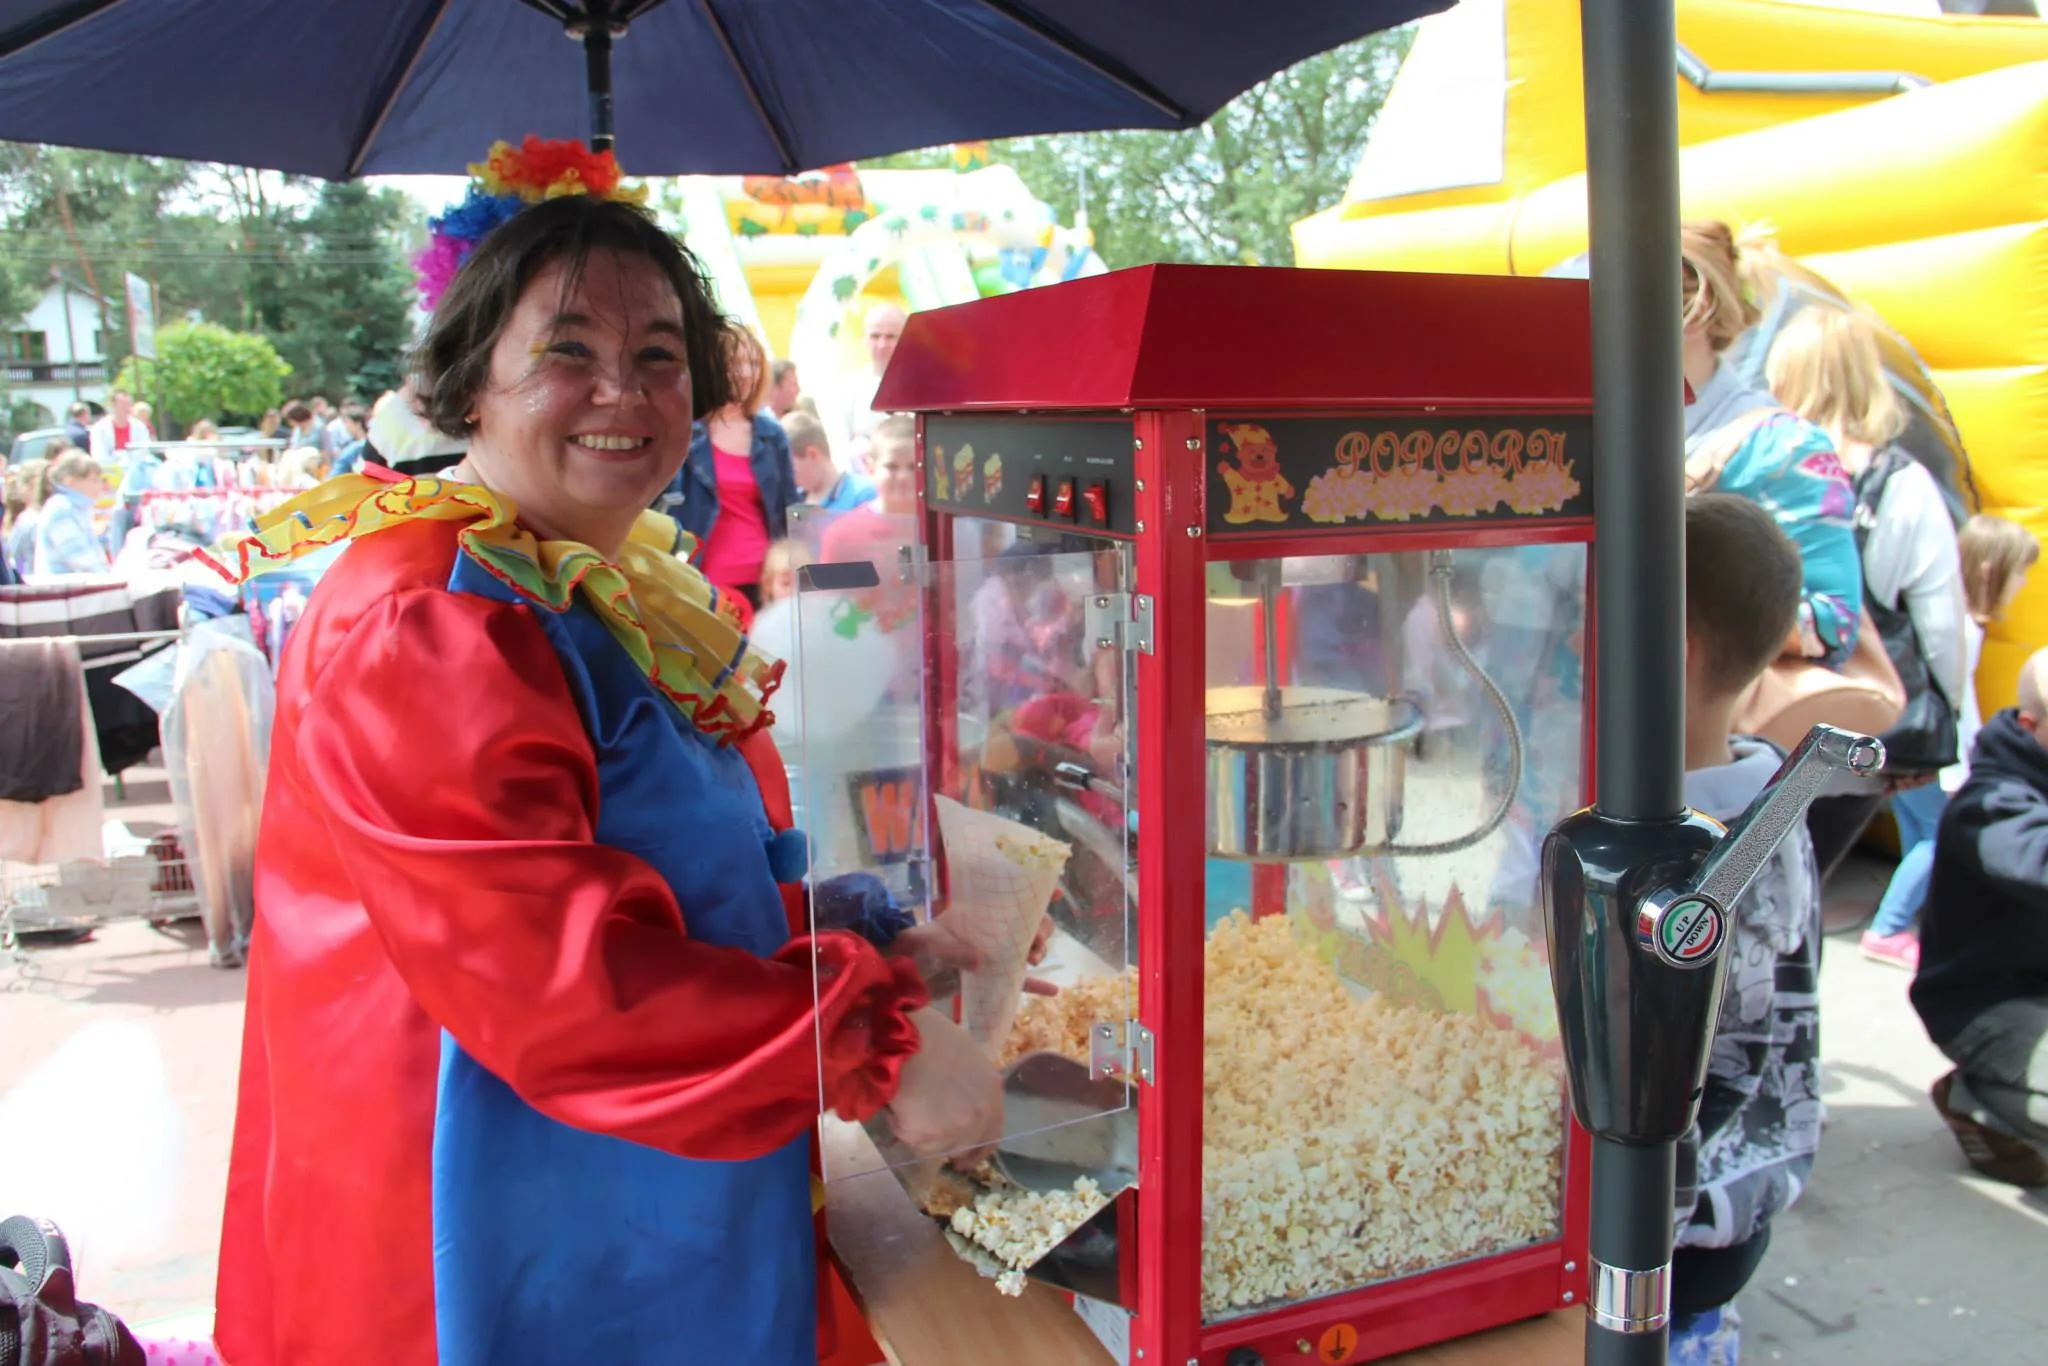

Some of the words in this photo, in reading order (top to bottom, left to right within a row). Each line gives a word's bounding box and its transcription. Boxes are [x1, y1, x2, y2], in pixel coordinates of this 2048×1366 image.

[1335, 428, 1574, 479] POPCORN
[1676, 916, 1690, 933] UP
[1686, 917, 1710, 947] DOWN
